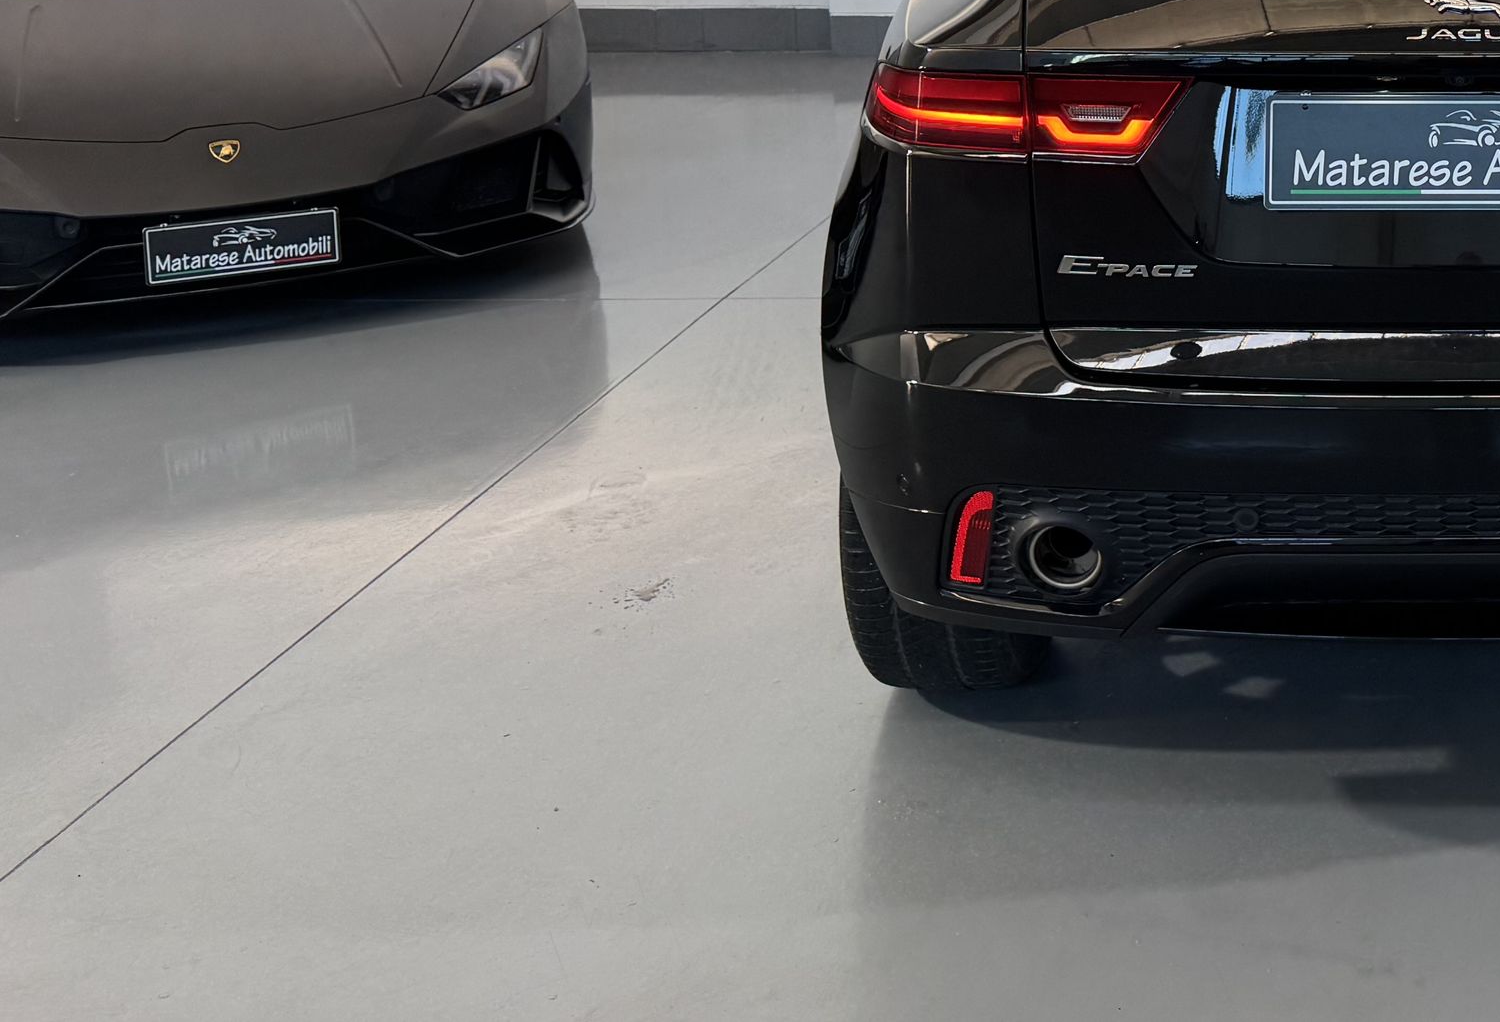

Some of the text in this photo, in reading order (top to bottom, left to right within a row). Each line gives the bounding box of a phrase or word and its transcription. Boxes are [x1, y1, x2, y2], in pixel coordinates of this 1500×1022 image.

[1293, 149, 1473, 187] Matarese
[155, 235, 331, 273] Matarese Automobili
